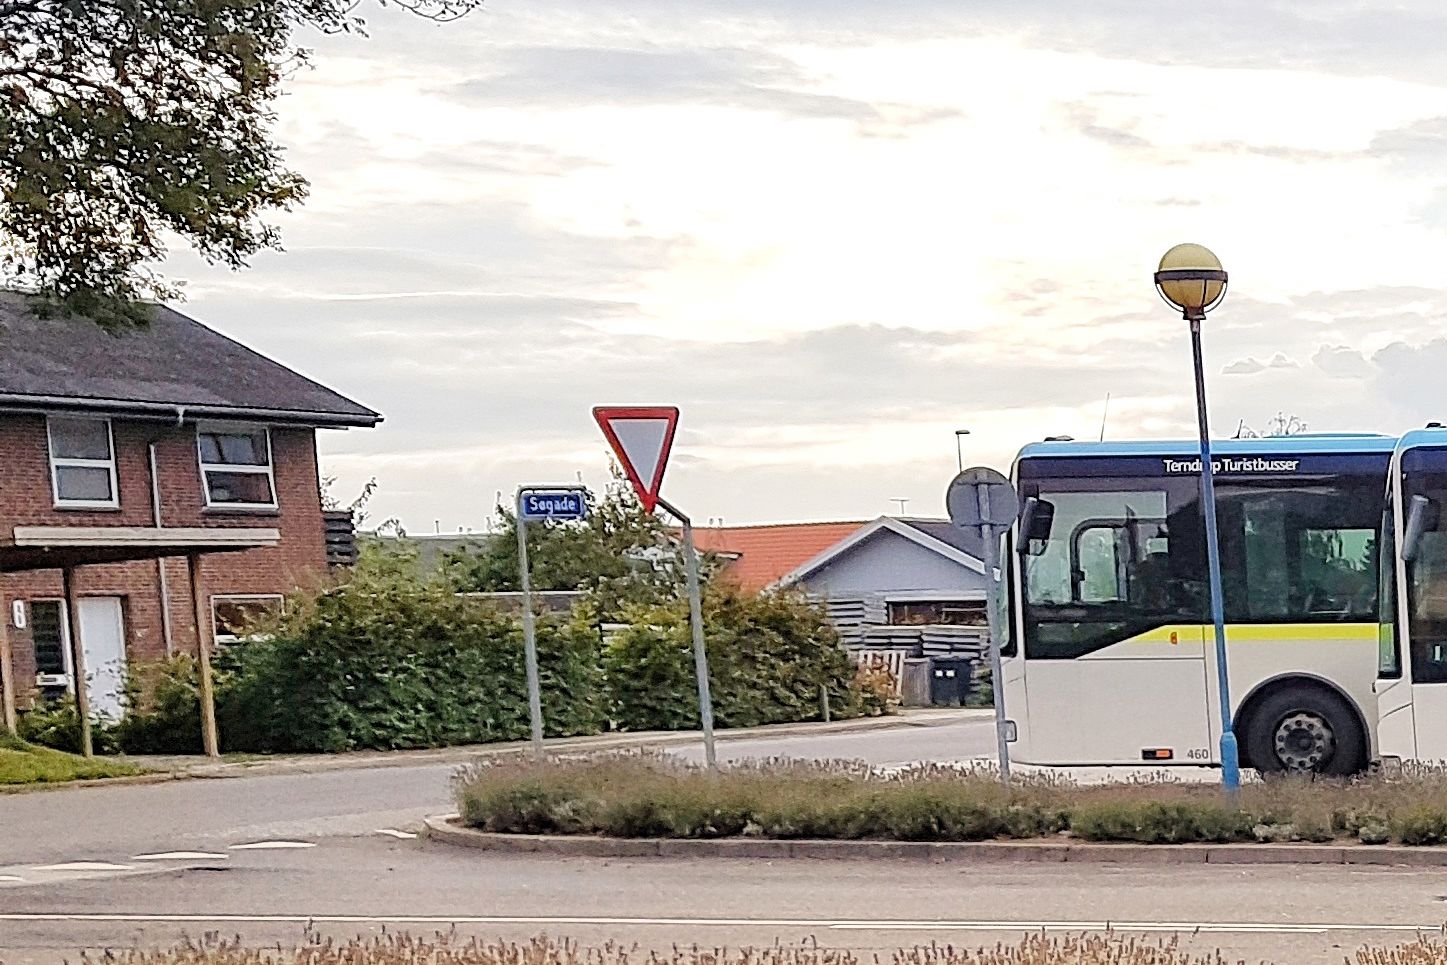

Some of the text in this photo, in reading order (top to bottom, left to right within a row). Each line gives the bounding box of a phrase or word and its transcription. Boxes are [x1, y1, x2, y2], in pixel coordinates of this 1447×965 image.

[1222, 458, 1299, 471] Turistbusser
[529, 496, 576, 515] Søgade
[1187, 748, 1209, 760] 460
